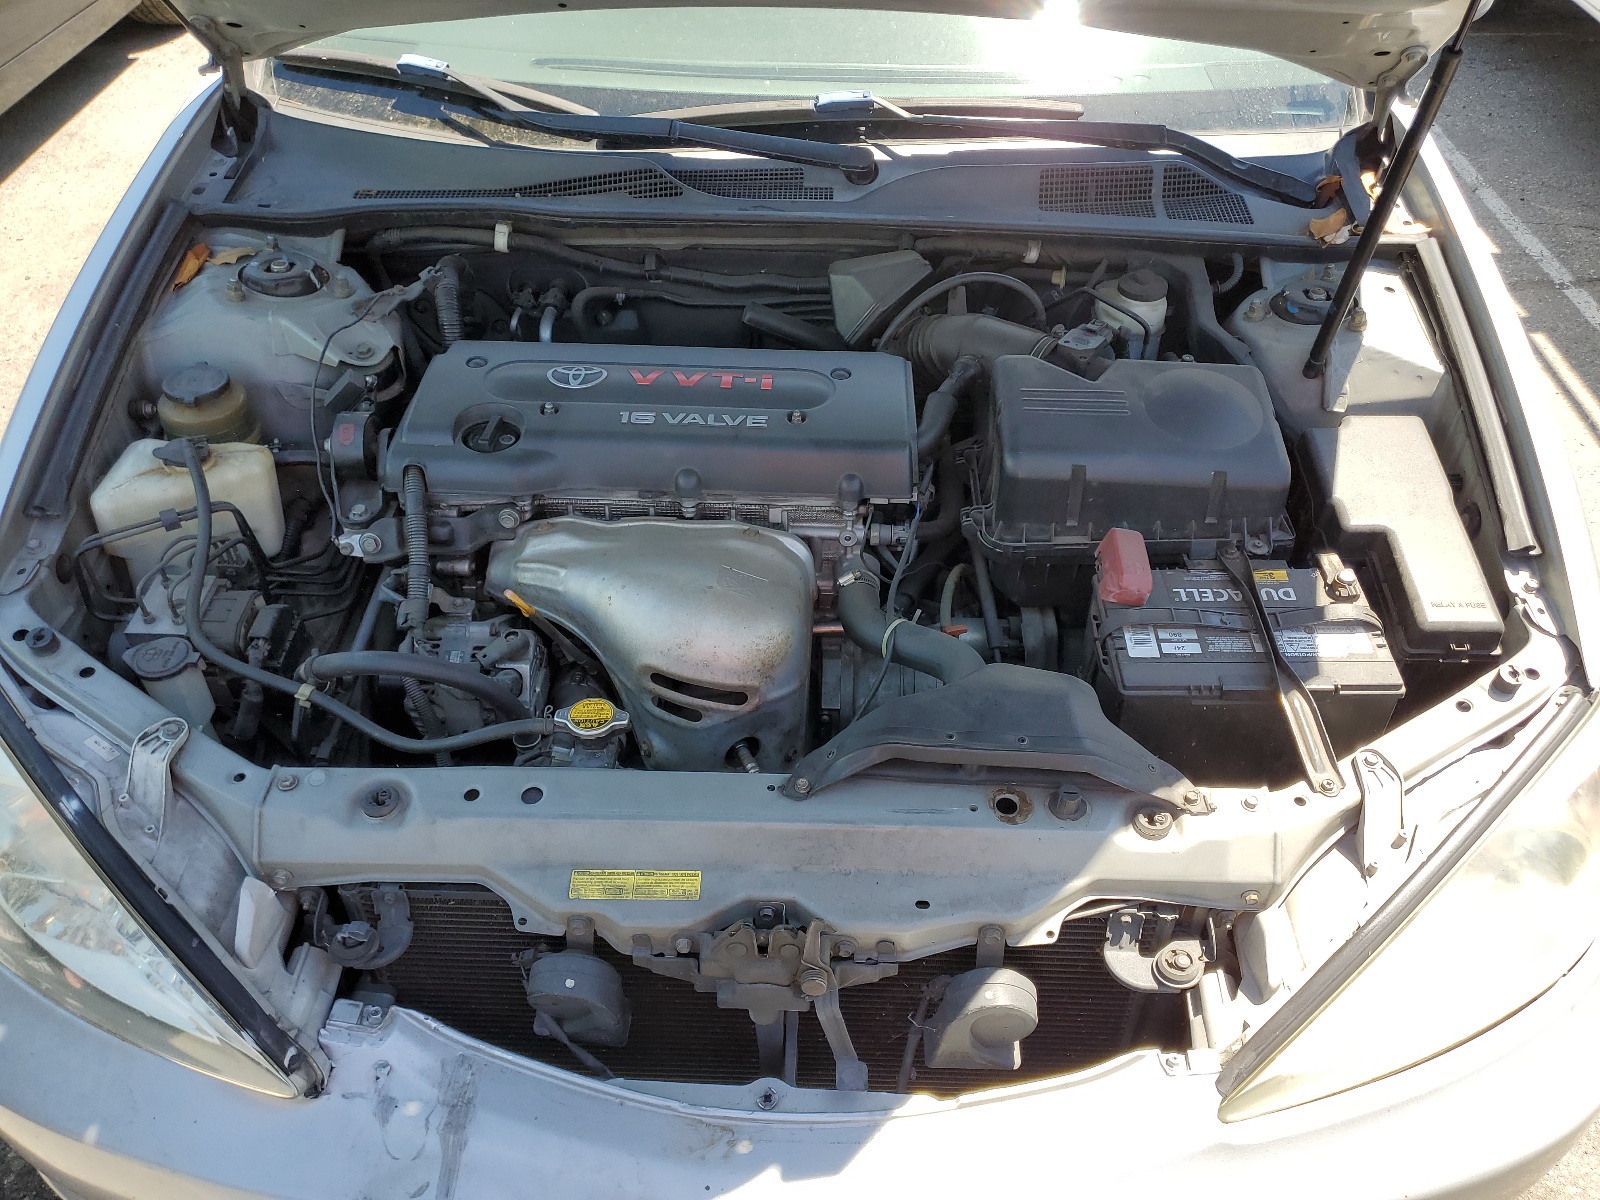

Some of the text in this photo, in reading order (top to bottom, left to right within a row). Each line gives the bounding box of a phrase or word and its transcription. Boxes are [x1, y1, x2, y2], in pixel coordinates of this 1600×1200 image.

[620, 411, 769, 428] 16 VALVE
[1173, 588, 1296, 602] DUACELL
